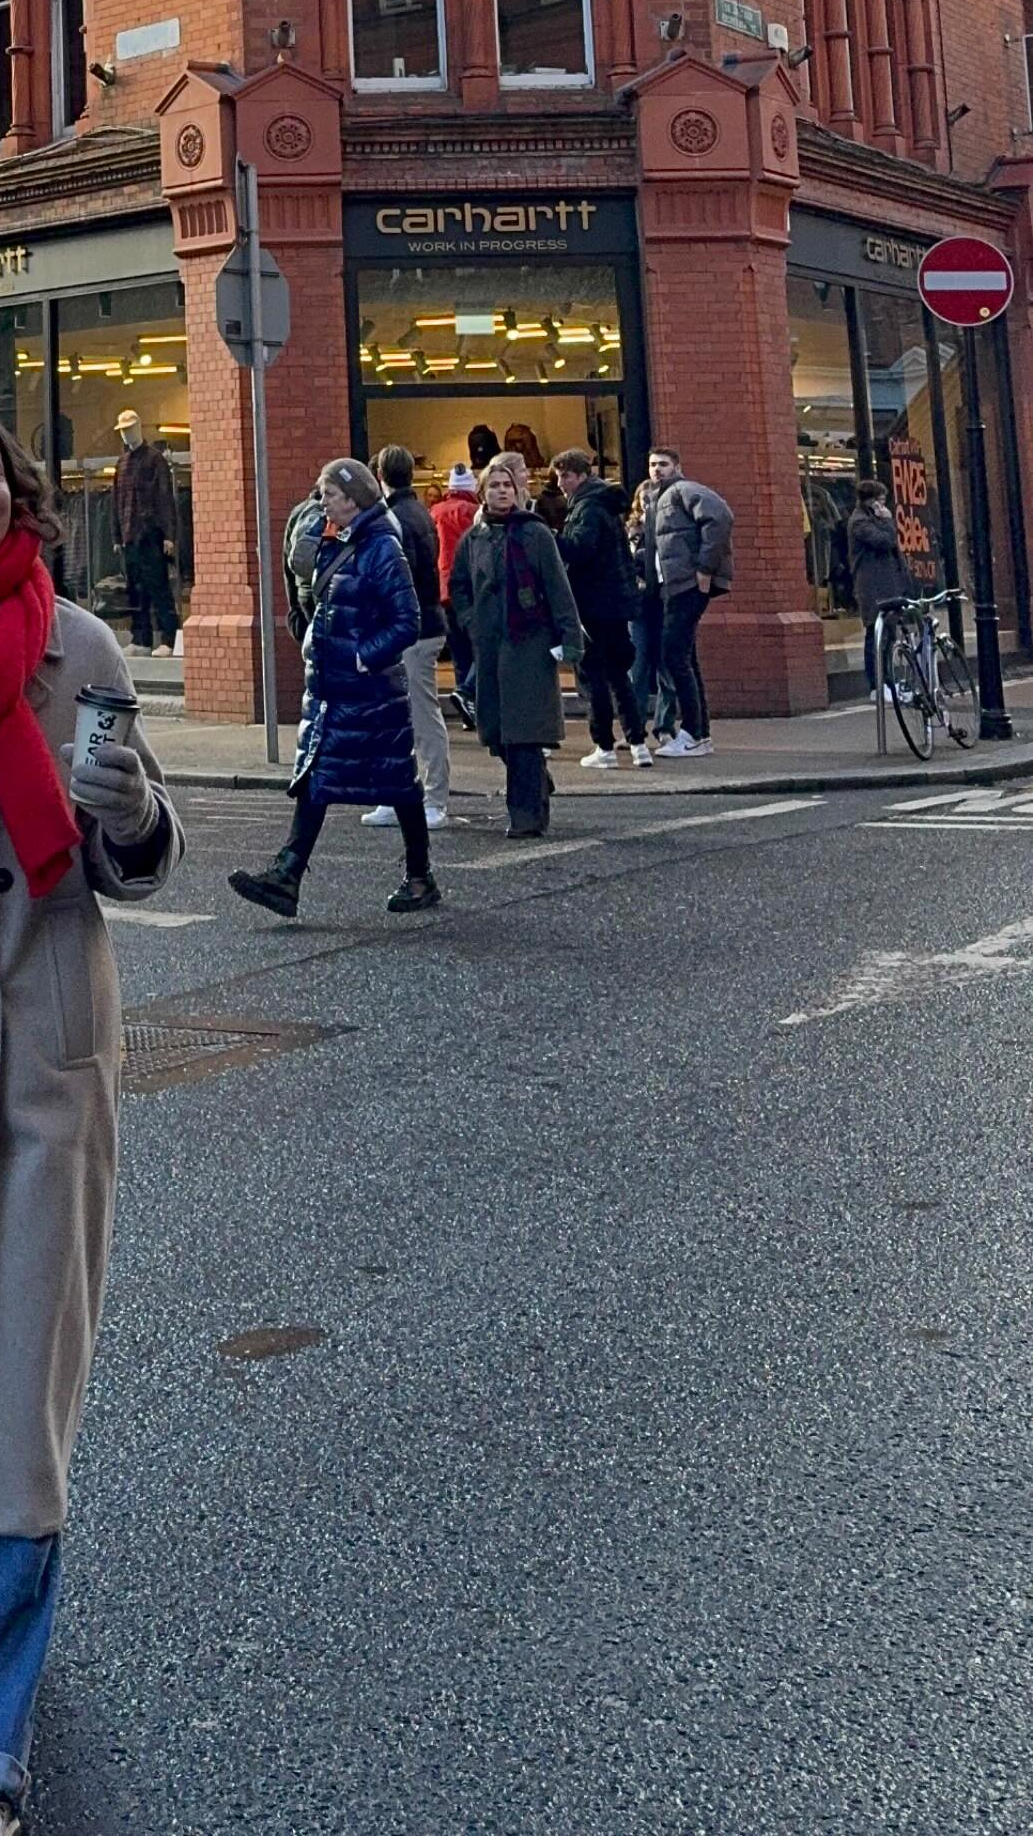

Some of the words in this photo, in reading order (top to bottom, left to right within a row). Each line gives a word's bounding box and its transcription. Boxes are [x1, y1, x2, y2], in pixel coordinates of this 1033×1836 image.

[375, 200, 597, 235] carhartt
[407, 241, 456, 252] WORK
[460, 241, 475, 251] IN
[479, 239, 568, 251] PROGRESS
